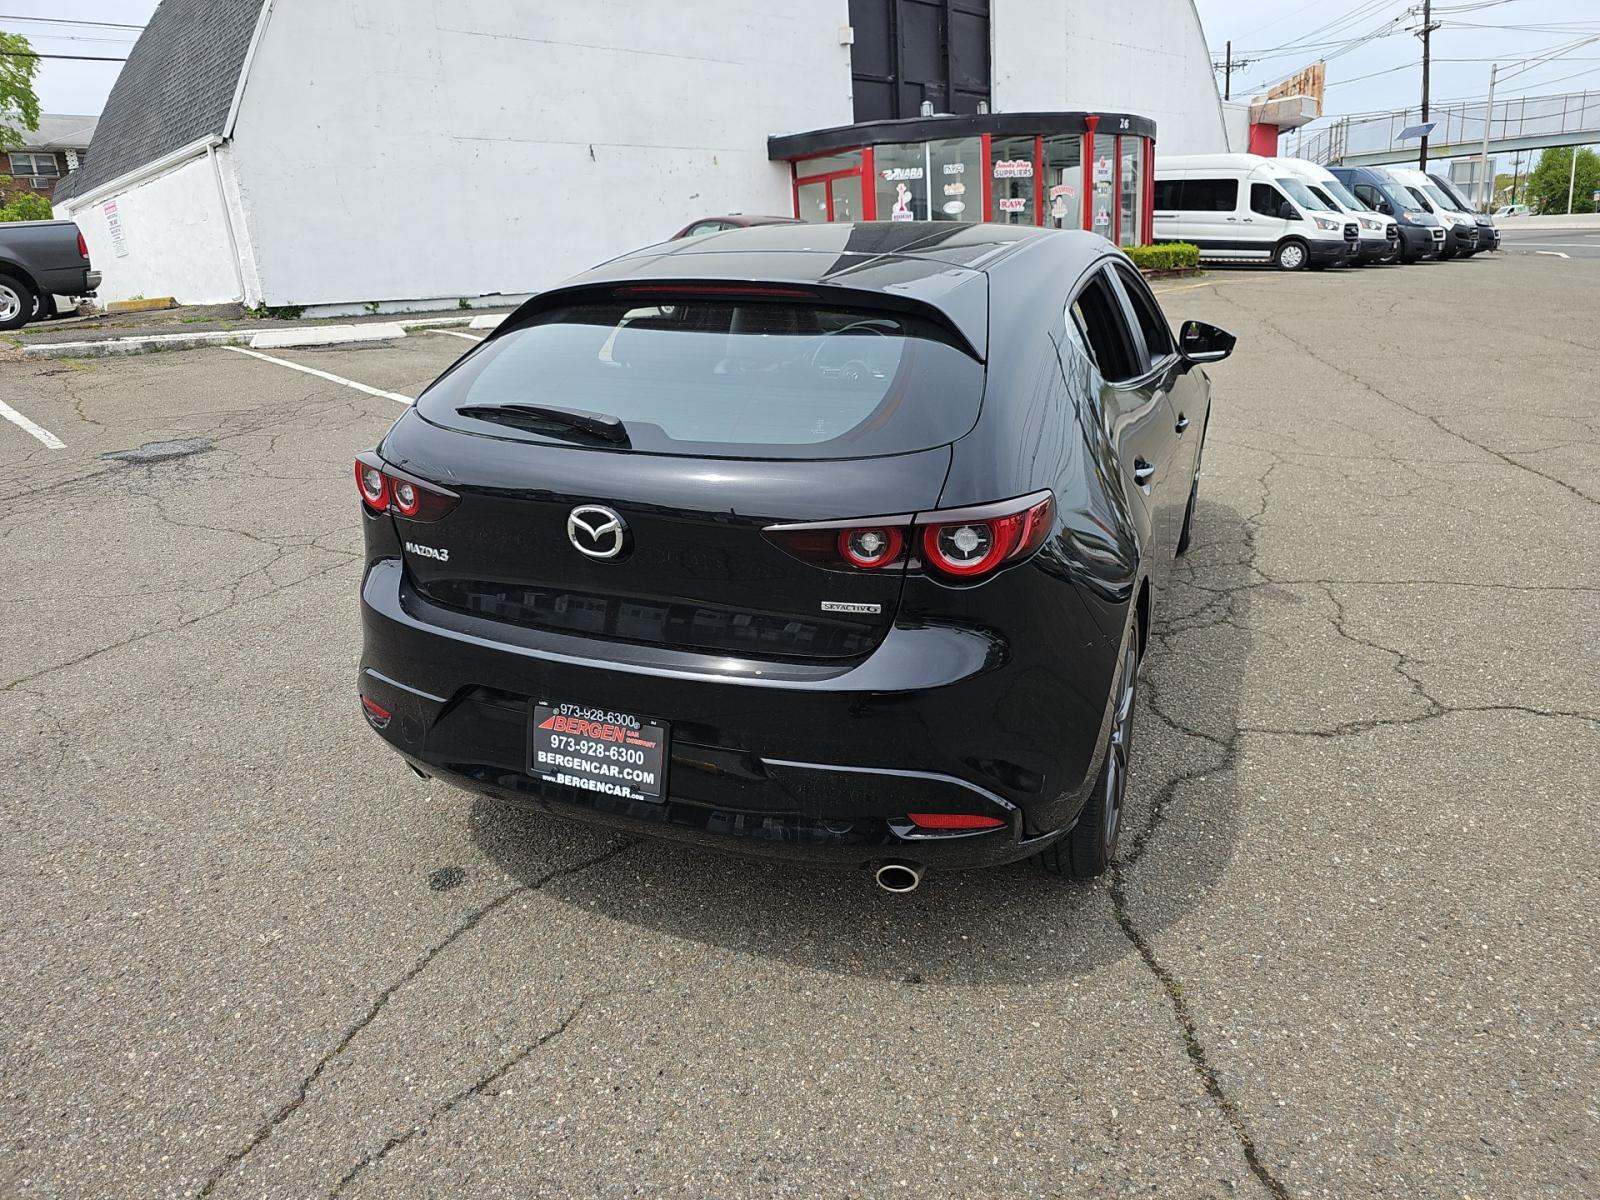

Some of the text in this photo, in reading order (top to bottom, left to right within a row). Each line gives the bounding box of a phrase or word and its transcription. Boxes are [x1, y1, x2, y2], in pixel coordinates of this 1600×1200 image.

[995, 169, 1032, 177] SUPPLIERS
[1001, 199, 1023, 209] RAW
[405, 541, 449, 562] MAZDA3
[559, 703, 635, 728] 973-928-6300
[553, 715, 626, 743] BERGEN
[550, 734, 644, 765] 973-928-6300
[537, 750, 655, 785] BERGENCAR.COM
